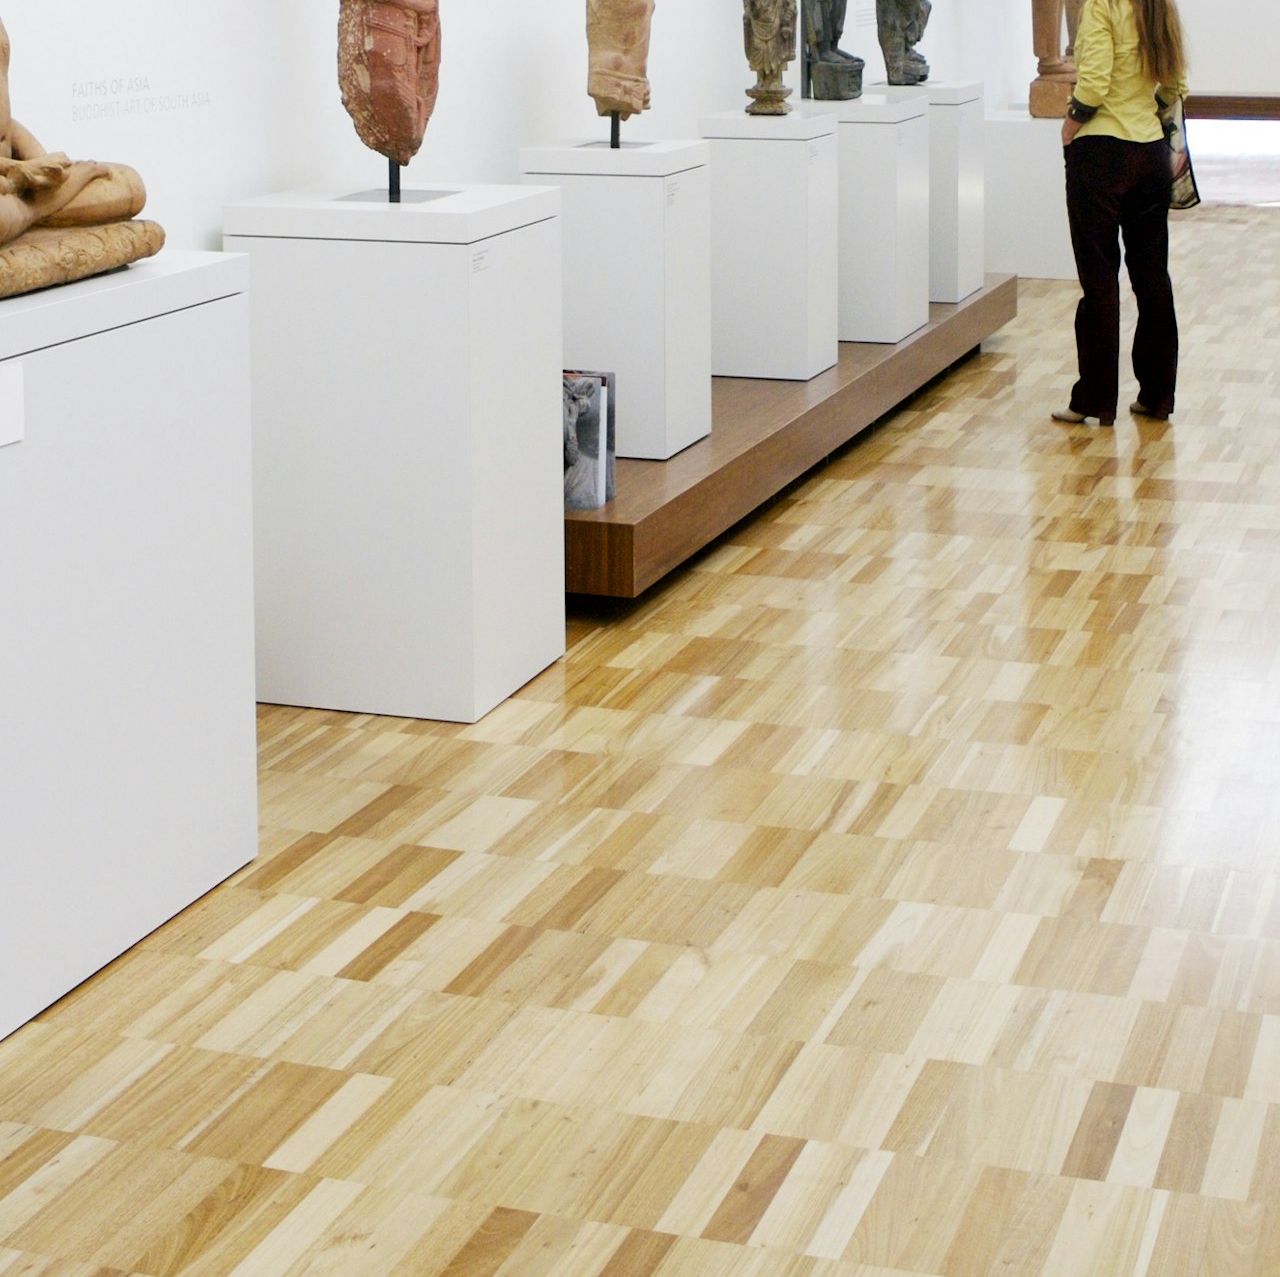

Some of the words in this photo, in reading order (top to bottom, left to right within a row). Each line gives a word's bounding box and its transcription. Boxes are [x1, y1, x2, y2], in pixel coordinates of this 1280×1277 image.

[72, 80, 107, 98] FAITHS
[110, 78, 125, 95] OF
[127, 76, 150, 93] ASIA
[72, 100, 120, 121] BUDDHIST
[124, 99, 140, 115] ART
[143, 97, 156, 113] OF
[158, 94, 189, 112] SOUTH
[191, 91, 211, 108] ASIA
